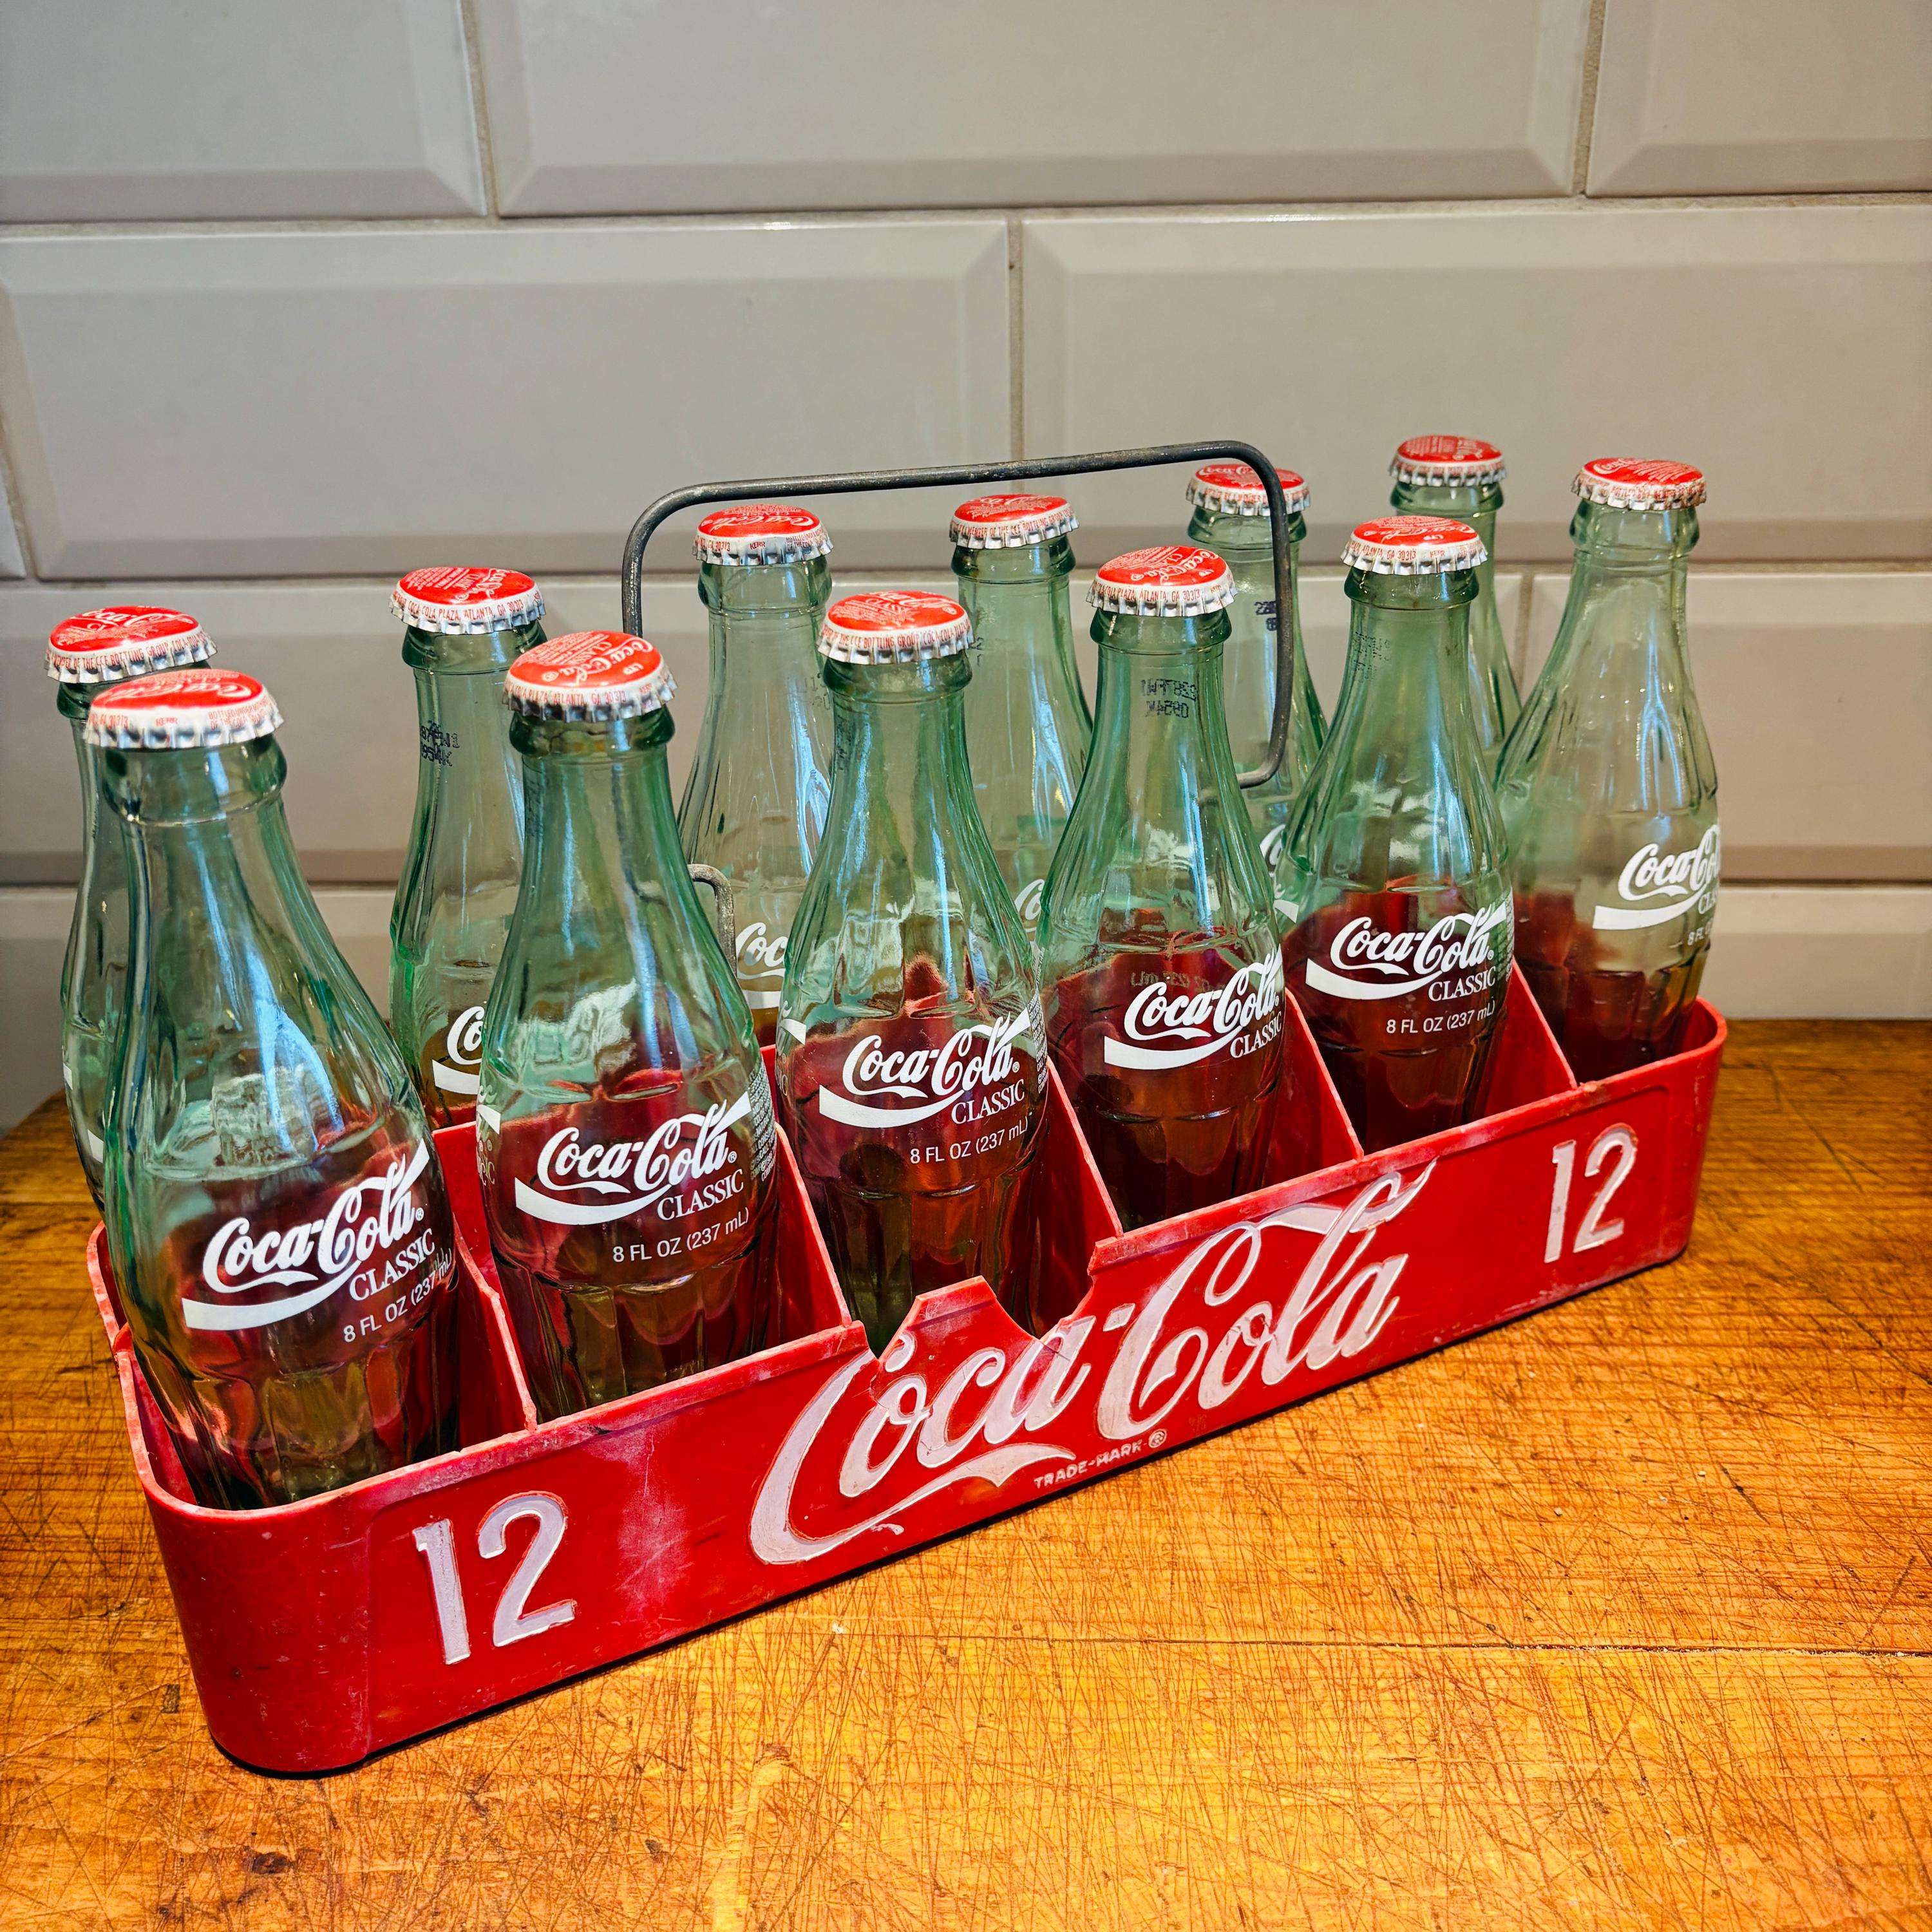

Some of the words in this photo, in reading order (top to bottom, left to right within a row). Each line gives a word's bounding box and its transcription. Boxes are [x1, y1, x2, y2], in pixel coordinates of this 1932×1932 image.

[750, 541, 766, 550] KERR
[463, 606, 495, 621] ATLANTA,
[497, 604, 506, 617] GA
[508, 599, 524, 613] 30313
[1171, 591, 1180, 603] GA
[1182, 589, 1201, 601] 30313
[110, 649, 145, 667] BOTTLING
[558, 636, 654, 685] Coca-Cola
[864, 636, 895, 650] BOTTLING
[604, 690, 627, 705] 30313
[1428, 966, 1496, 1002] CLASSIC
[1229, 1010, 1283, 1059] CLASSIC
[1386, 1019, 1396, 1034] 8
[1401, 1019, 1418, 1034] FL
[1423, 1017, 1443, 1033] OZ
[1446, 1012, 1473, 1031] (237
[1477, 999, 1495, 1021] mL)
[951, 1079, 1026, 1125] CLASSIC
[909, 1147, 921, 1164] 8
[925, 1145, 945, 1163] FL
[949, 1139, 972, 1159] OZ
[976, 1131, 1006, 1155] (237
[1009, 1117, 1029, 1145] mL)
[657, 1168, 744, 1221] CLASSIC
[1544, 1122, 1638, 1264] 12
[612, 1245, 626, 1263] 8
[630, 1244, 652, 1261] FL
[657, 1236, 683, 1258] OZ
[686, 1227, 721, 1253] (237
[725, 1208, 750, 1237] mL)
[348, 1227, 435, 1302] CLASSIC
[343, 1324, 356, 1344] 8
[359, 1314, 383, 1338] FL
[384, 1300, 408, 1321] OZ
[411, 1270, 436, 1306] (237
[750, 1159, 1437, 1566] Coca-Cola
[1034, 1439, 1143, 1488] TRADE-MARK
[412, 1490, 578, 1665] 12
